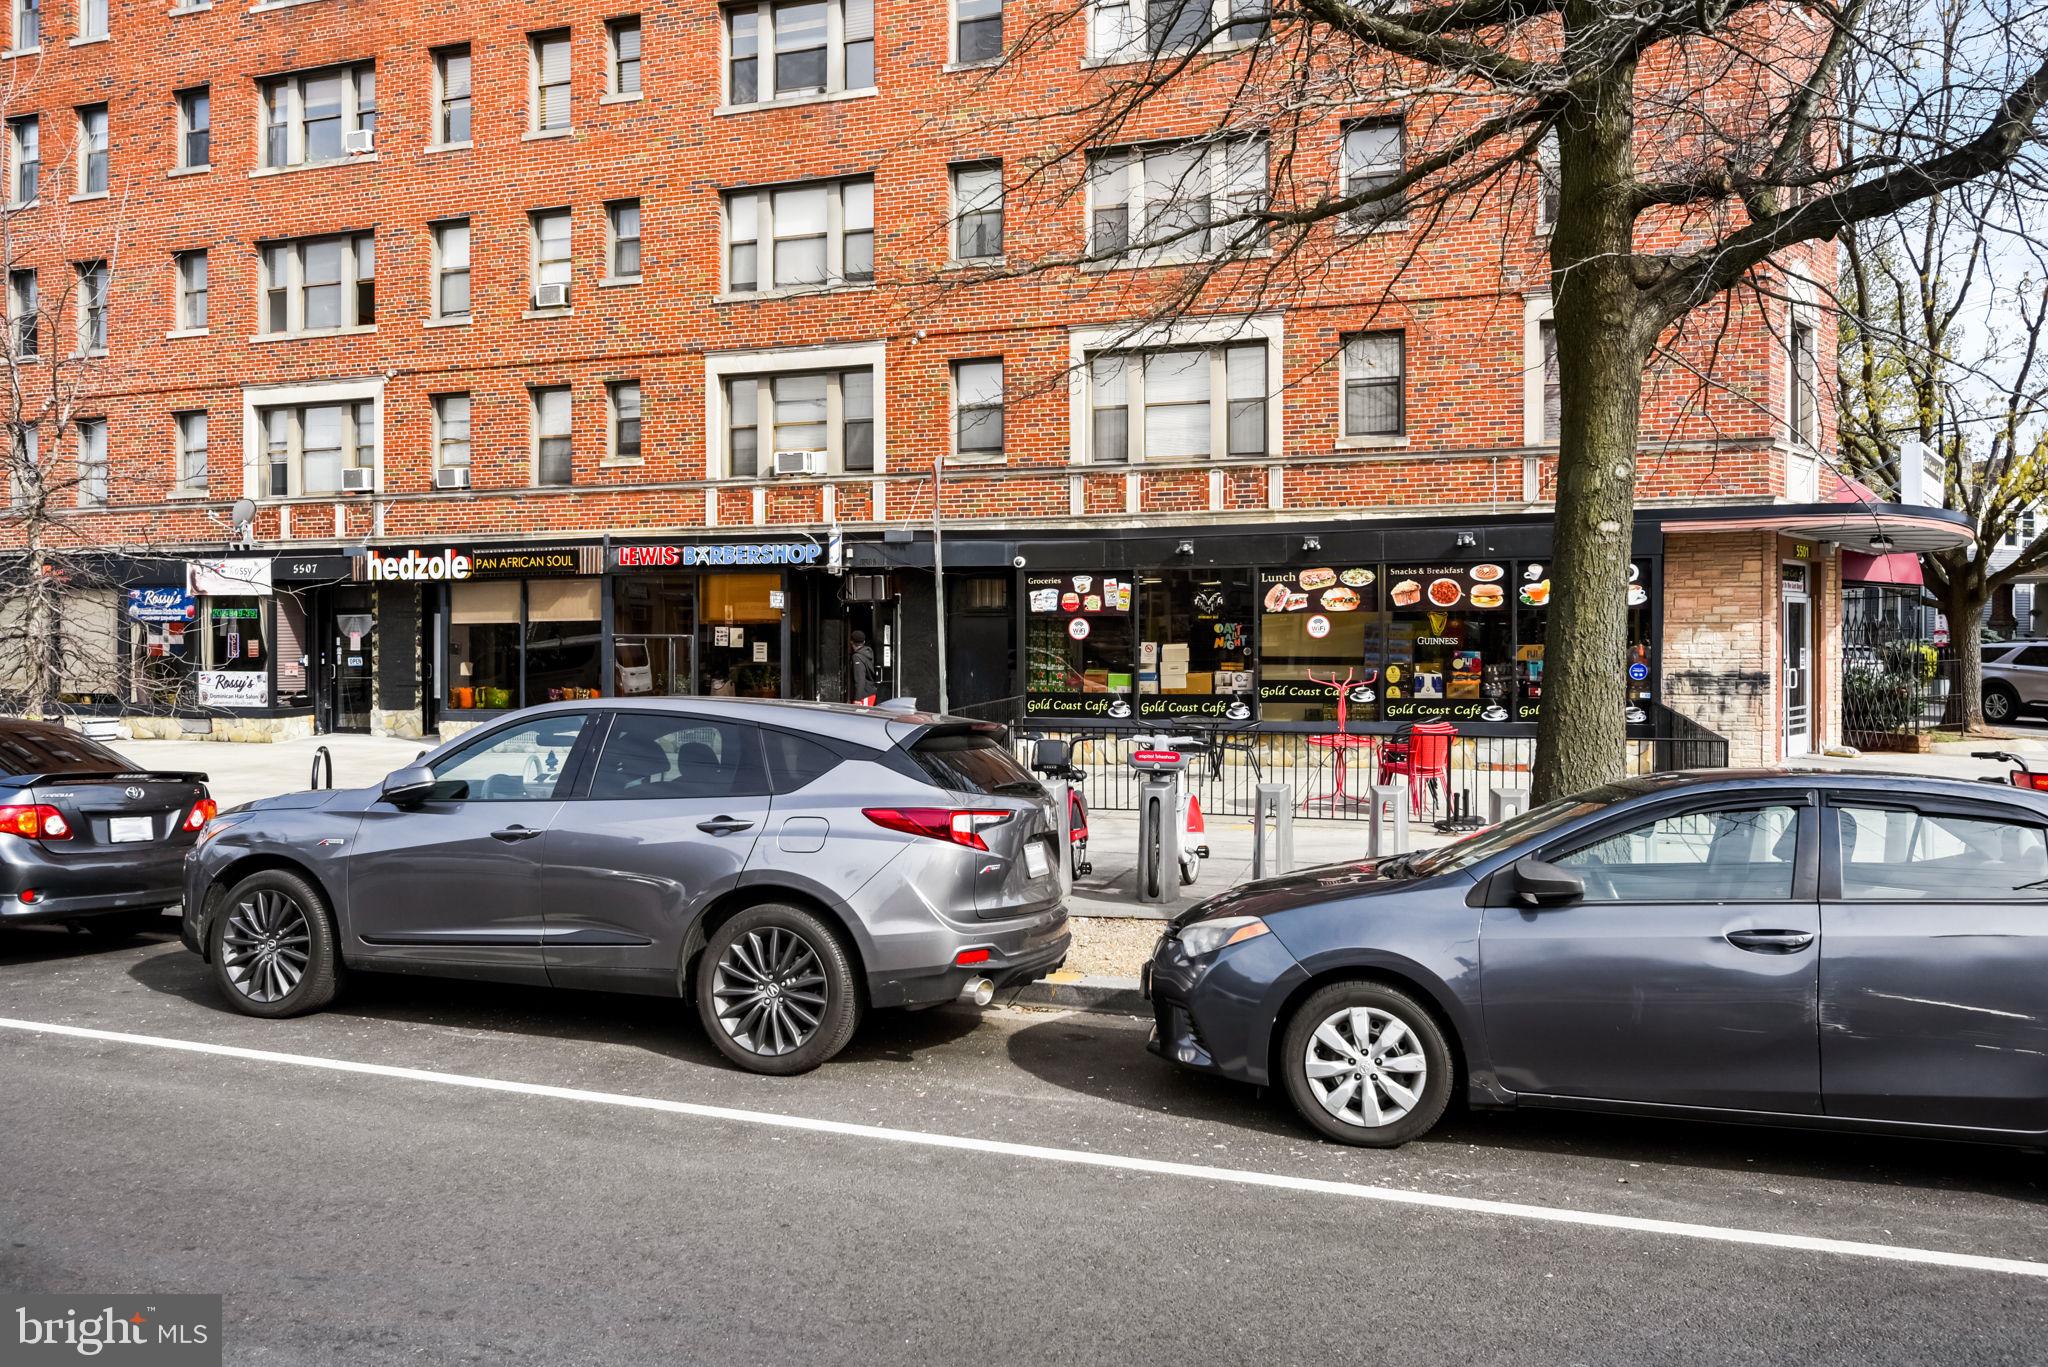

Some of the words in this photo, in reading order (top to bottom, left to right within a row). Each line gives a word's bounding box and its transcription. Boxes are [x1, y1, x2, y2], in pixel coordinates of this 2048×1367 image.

[618, 546, 681, 566] LEWIS
[683, 543, 823, 567] BARBERSHOP
[1796, 544, 1809, 558] 5501
[293, 563, 318, 574] 5507
[367, 547, 471, 581] hedzole
[475, 558, 497, 569] PAN
[499, 555, 545, 568] AFRICAN
[546, 554, 574, 567] SOUL
[1260, 571, 1296, 583] Lunch
[1390, 567, 1418, 576] Snacks
[1418, 567, 1425, 575] &
[1426, 567, 1464, 575] Breakfast
[1027, 577, 1062, 585] Groceries
[144, 590, 182, 607] Rossy's
[1416, 636, 1459, 645] GUINNESS
[349, 657, 363, 666] OPEN
[215, 674, 254, 692] Rossy's
[1260, 684, 1288, 698] Gold
[1289, 686, 1321, 697] Coast
[1324, 686, 1351, 700] Caé
[1027, 698, 1051, 713] Gold
[1053, 700, 1082, 710] Coast
[1084, 699, 1109, 716] Café
[1140, 700, 1166, 715] Gold
[1168, 701, 1199, 712] Coast
[1201, 700, 1227, 717] Café
[1386, 703, 1416, 717] Gold
[1417, 704, 1451, 715] Coast
[1454, 703, 1482, 719] Café
[1519, 704, 1541, 718] Gol
